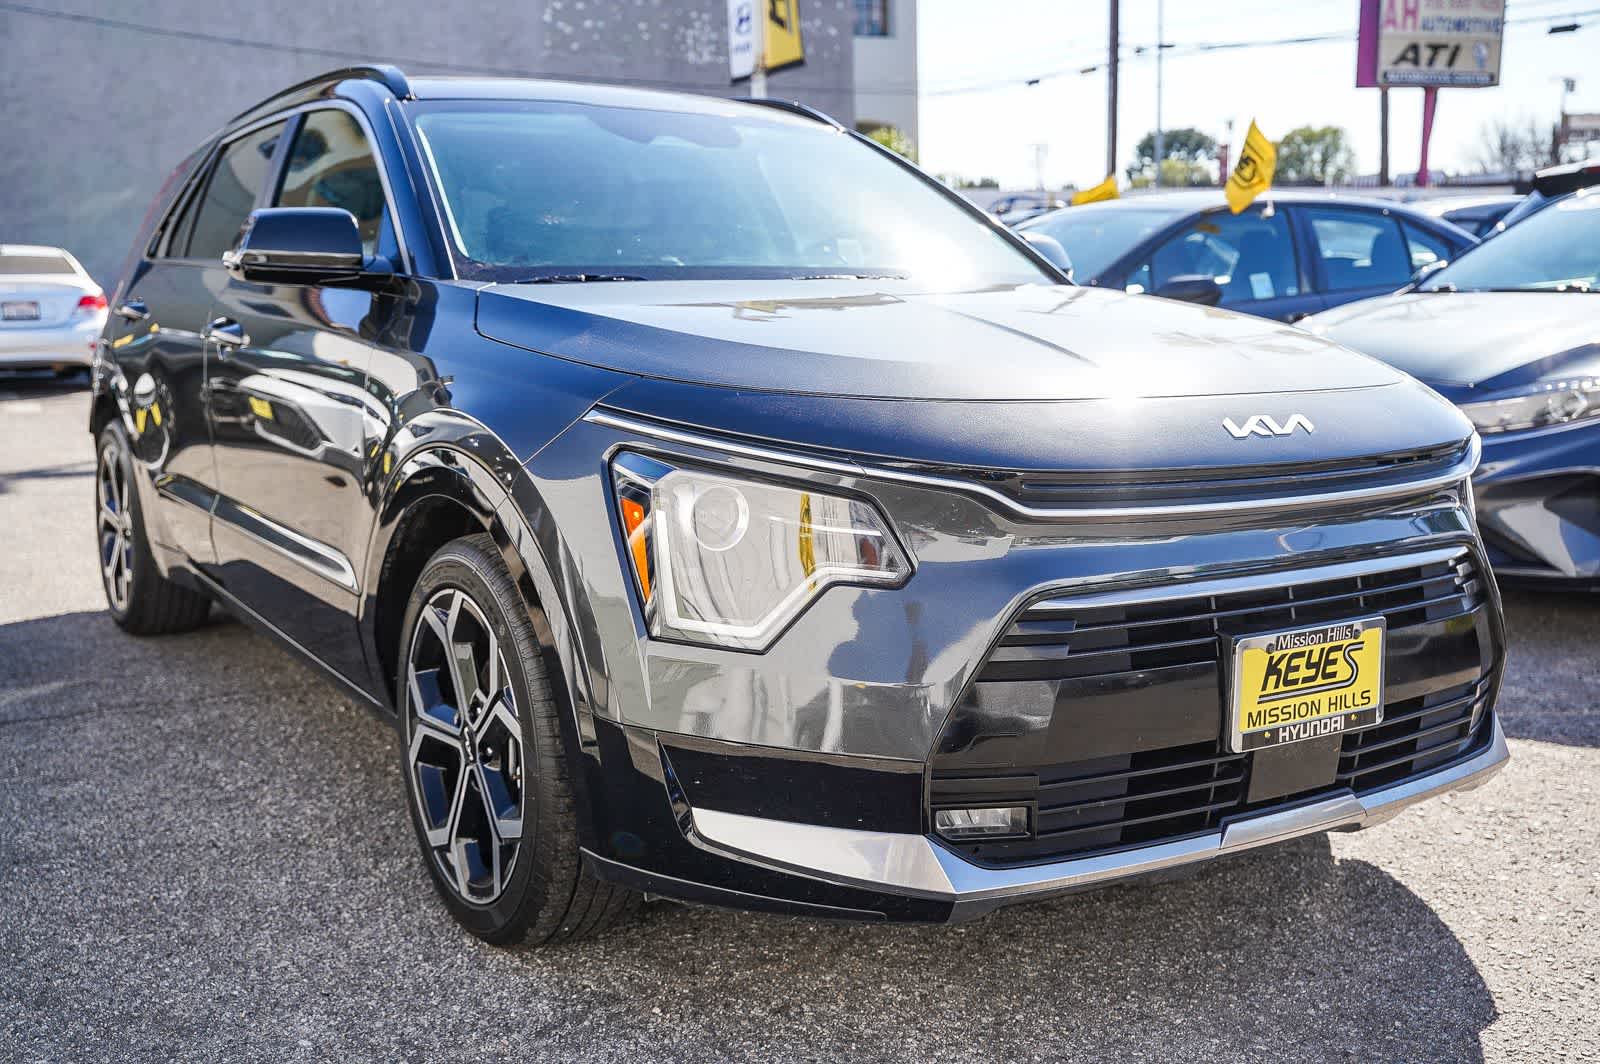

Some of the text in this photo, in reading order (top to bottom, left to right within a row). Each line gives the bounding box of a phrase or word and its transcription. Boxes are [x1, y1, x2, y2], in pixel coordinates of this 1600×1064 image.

[1392, 42, 1462, 68] ATI
[1277, 626, 1352, 650] Mission Hills
[1260, 641, 1365, 692] KEYES
[1247, 689, 1371, 729] MISSION HILLS
[1278, 715, 1345, 743] HYUNDAI
